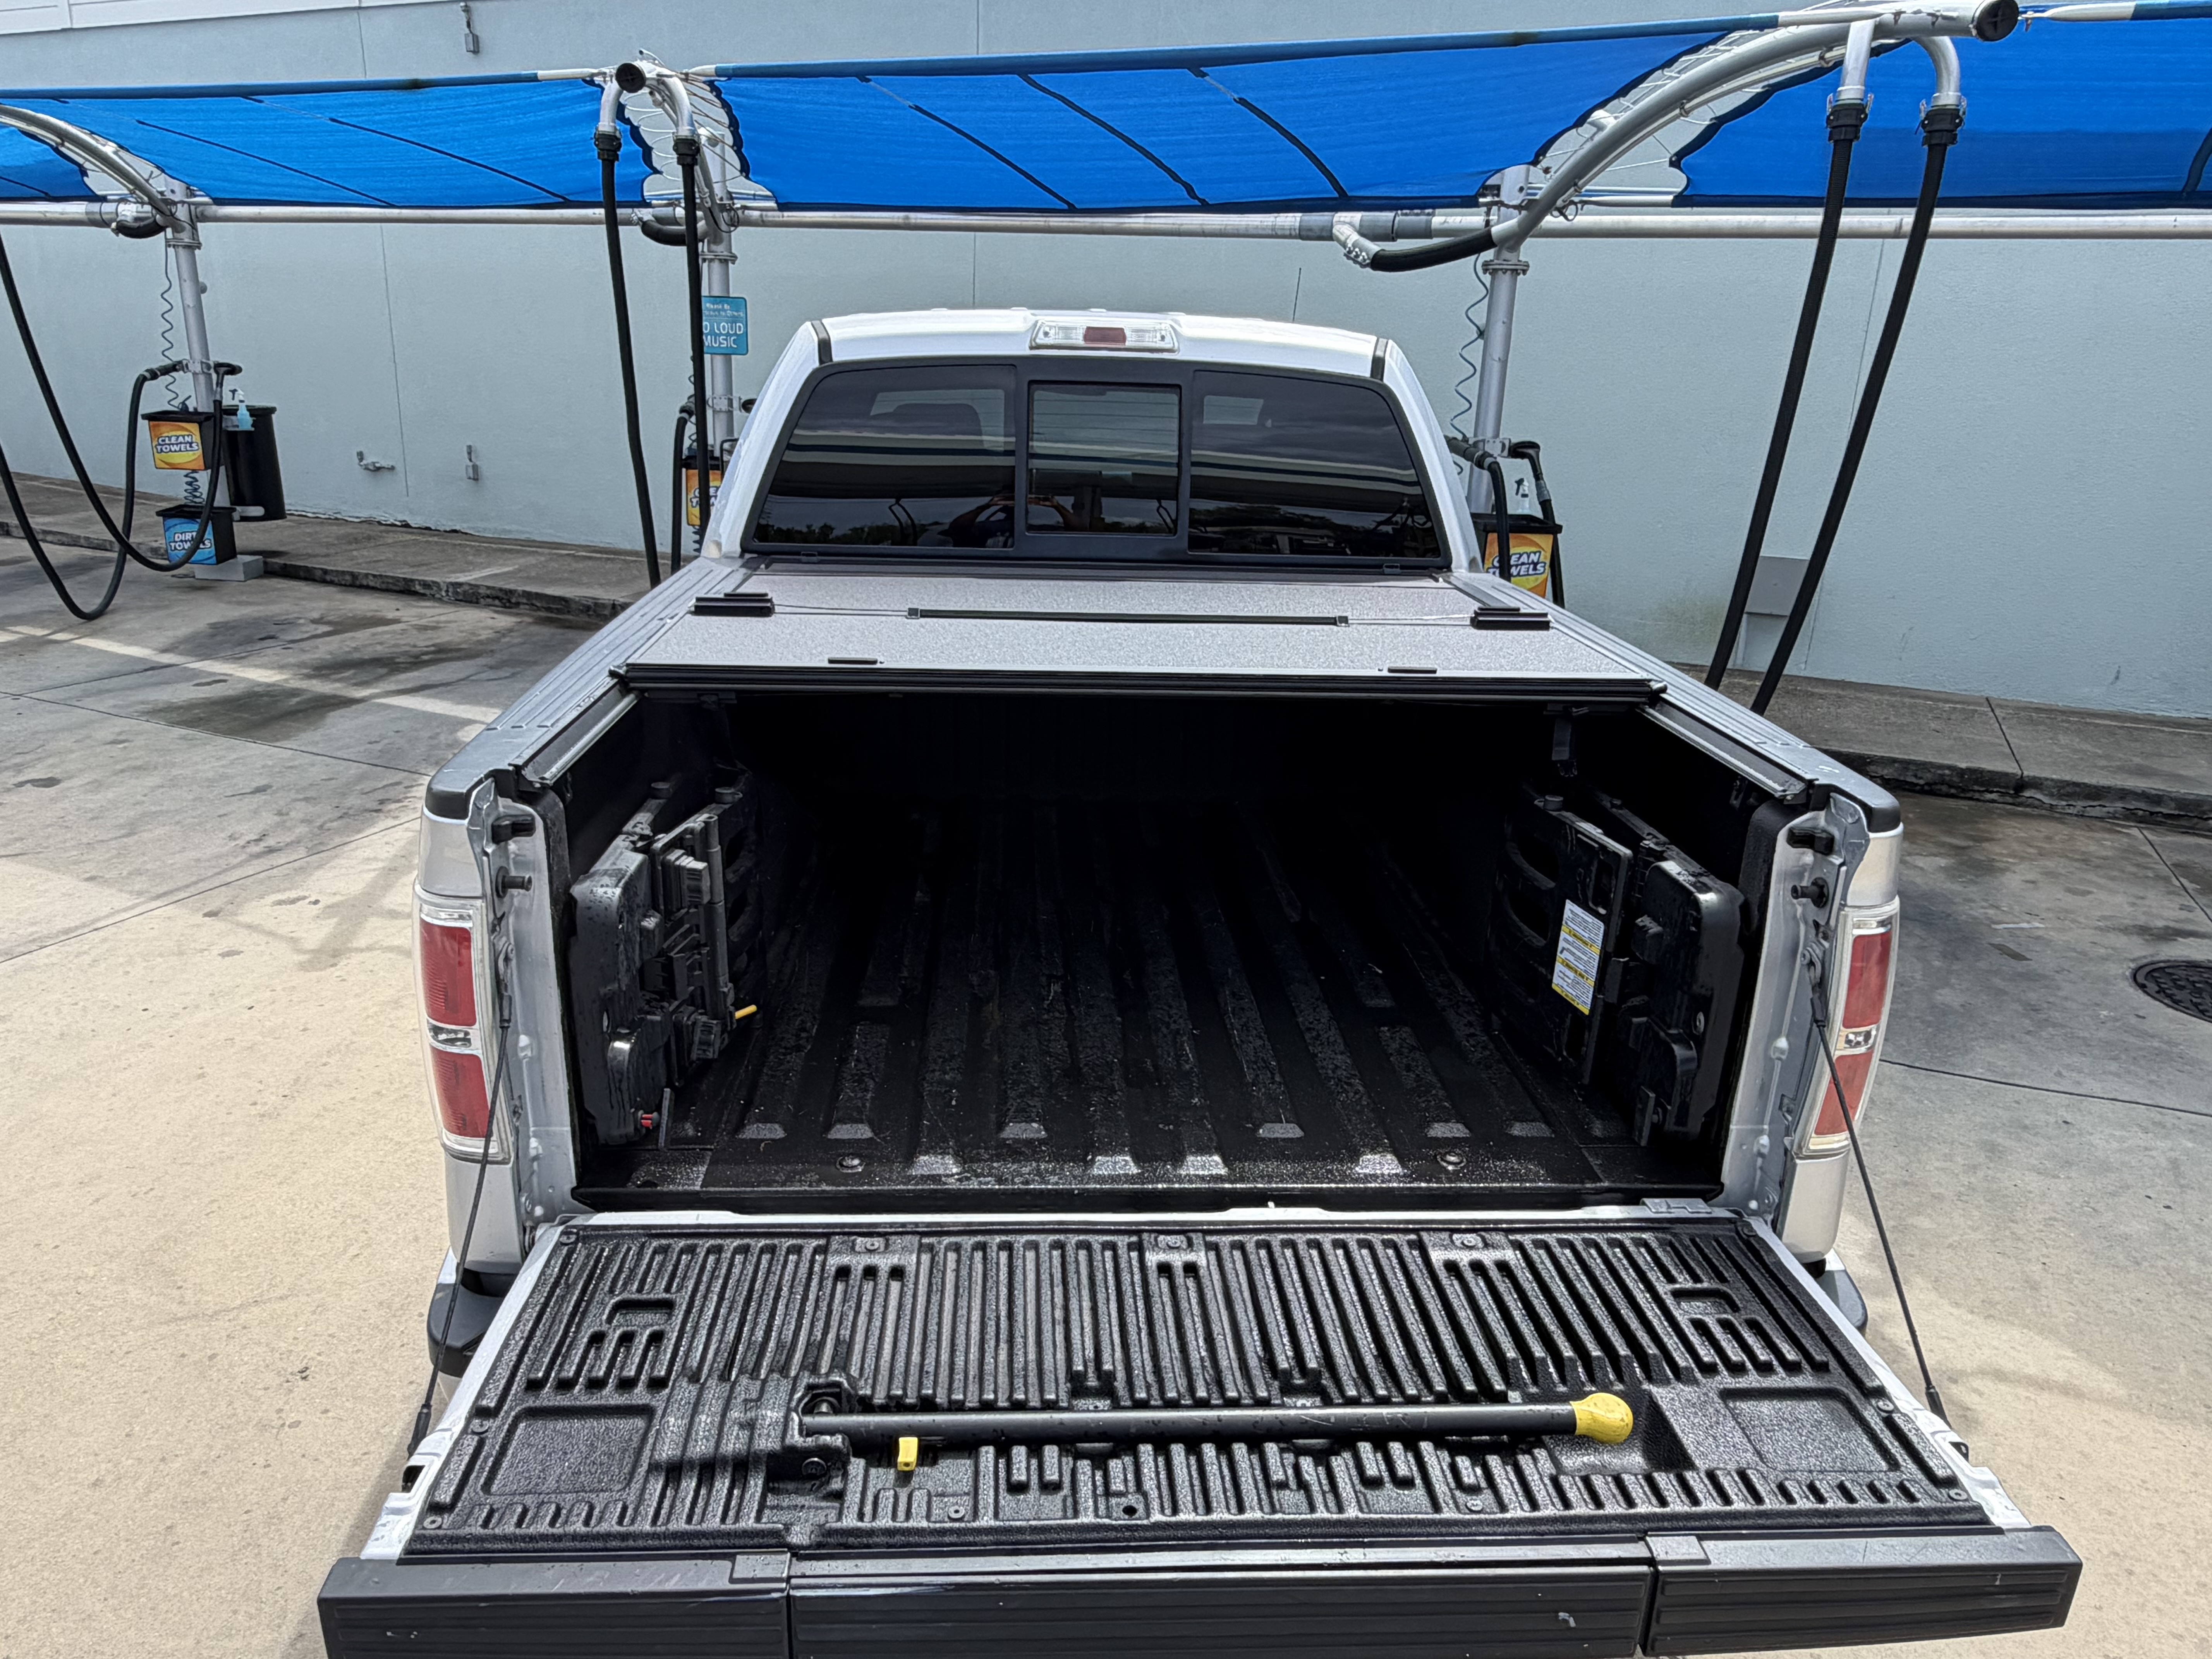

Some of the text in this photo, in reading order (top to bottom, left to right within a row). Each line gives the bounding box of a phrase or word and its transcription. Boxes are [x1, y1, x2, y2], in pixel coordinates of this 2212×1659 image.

[703, 321, 744, 334] O LOUD
[703, 335, 737, 348] MUSIC
[158, 435, 192, 444] CLEAN
[156, 443, 199, 453] TOWELS
[174, 532, 197, 541] DIRT
[1493, 552, 1540, 567] CEAN
